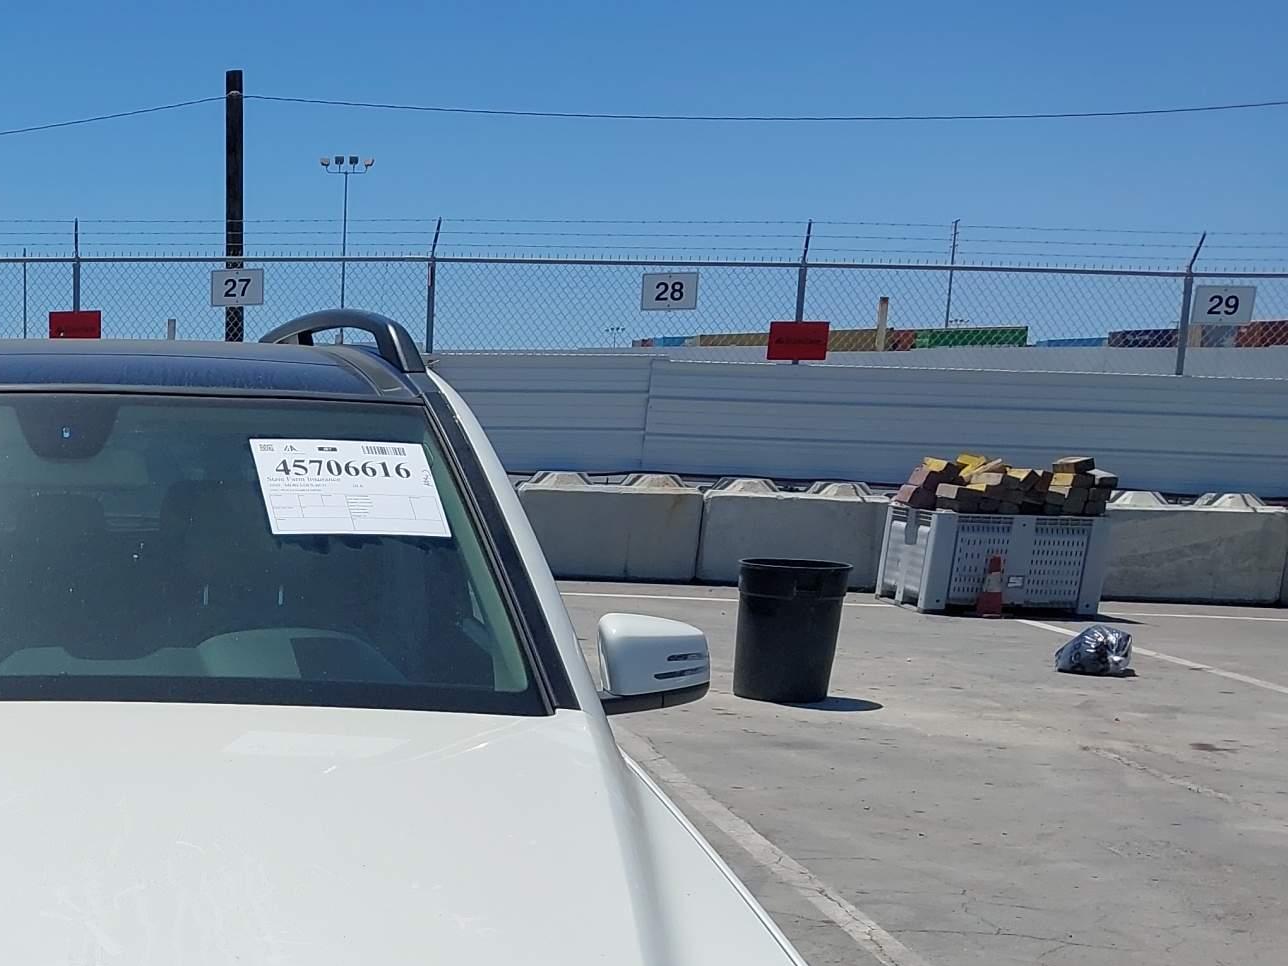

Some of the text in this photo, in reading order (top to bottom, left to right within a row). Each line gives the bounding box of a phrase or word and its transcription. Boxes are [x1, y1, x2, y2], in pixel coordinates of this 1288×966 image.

[223, 278, 252, 298] 27
[654, 281, 684, 302] 28
[1207, 294, 1240, 316] 29
[275, 458, 412, 480] 45706616
